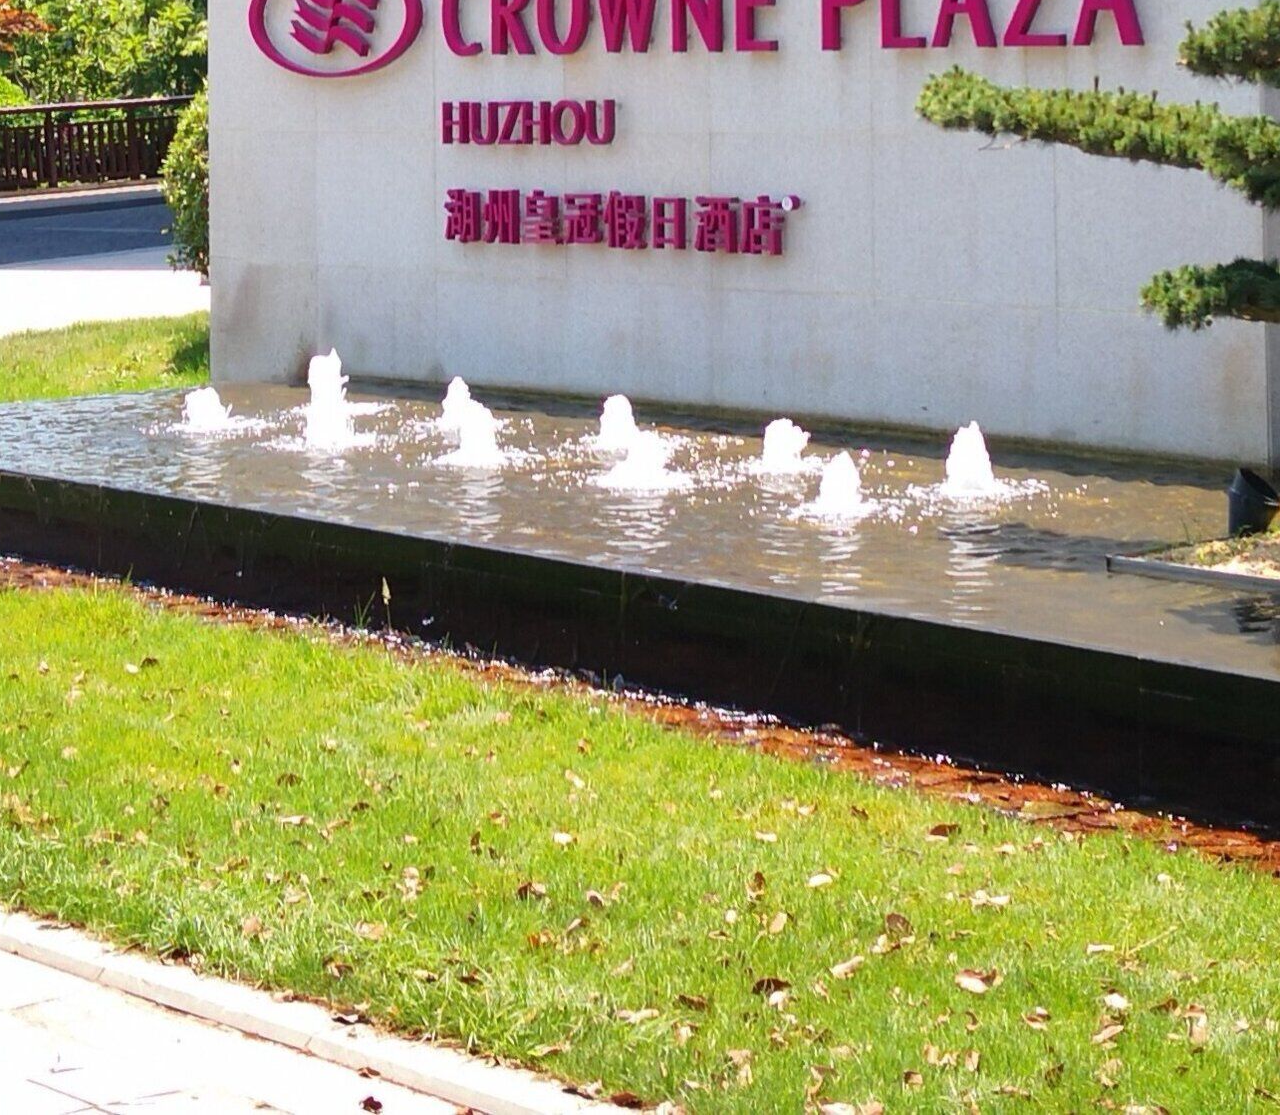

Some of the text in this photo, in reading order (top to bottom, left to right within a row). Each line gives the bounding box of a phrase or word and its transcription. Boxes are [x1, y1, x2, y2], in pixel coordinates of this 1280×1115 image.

[441, 99, 617, 145] HUZHOU
[444, 189, 786, 256] 湖州皇冠假日酒店
